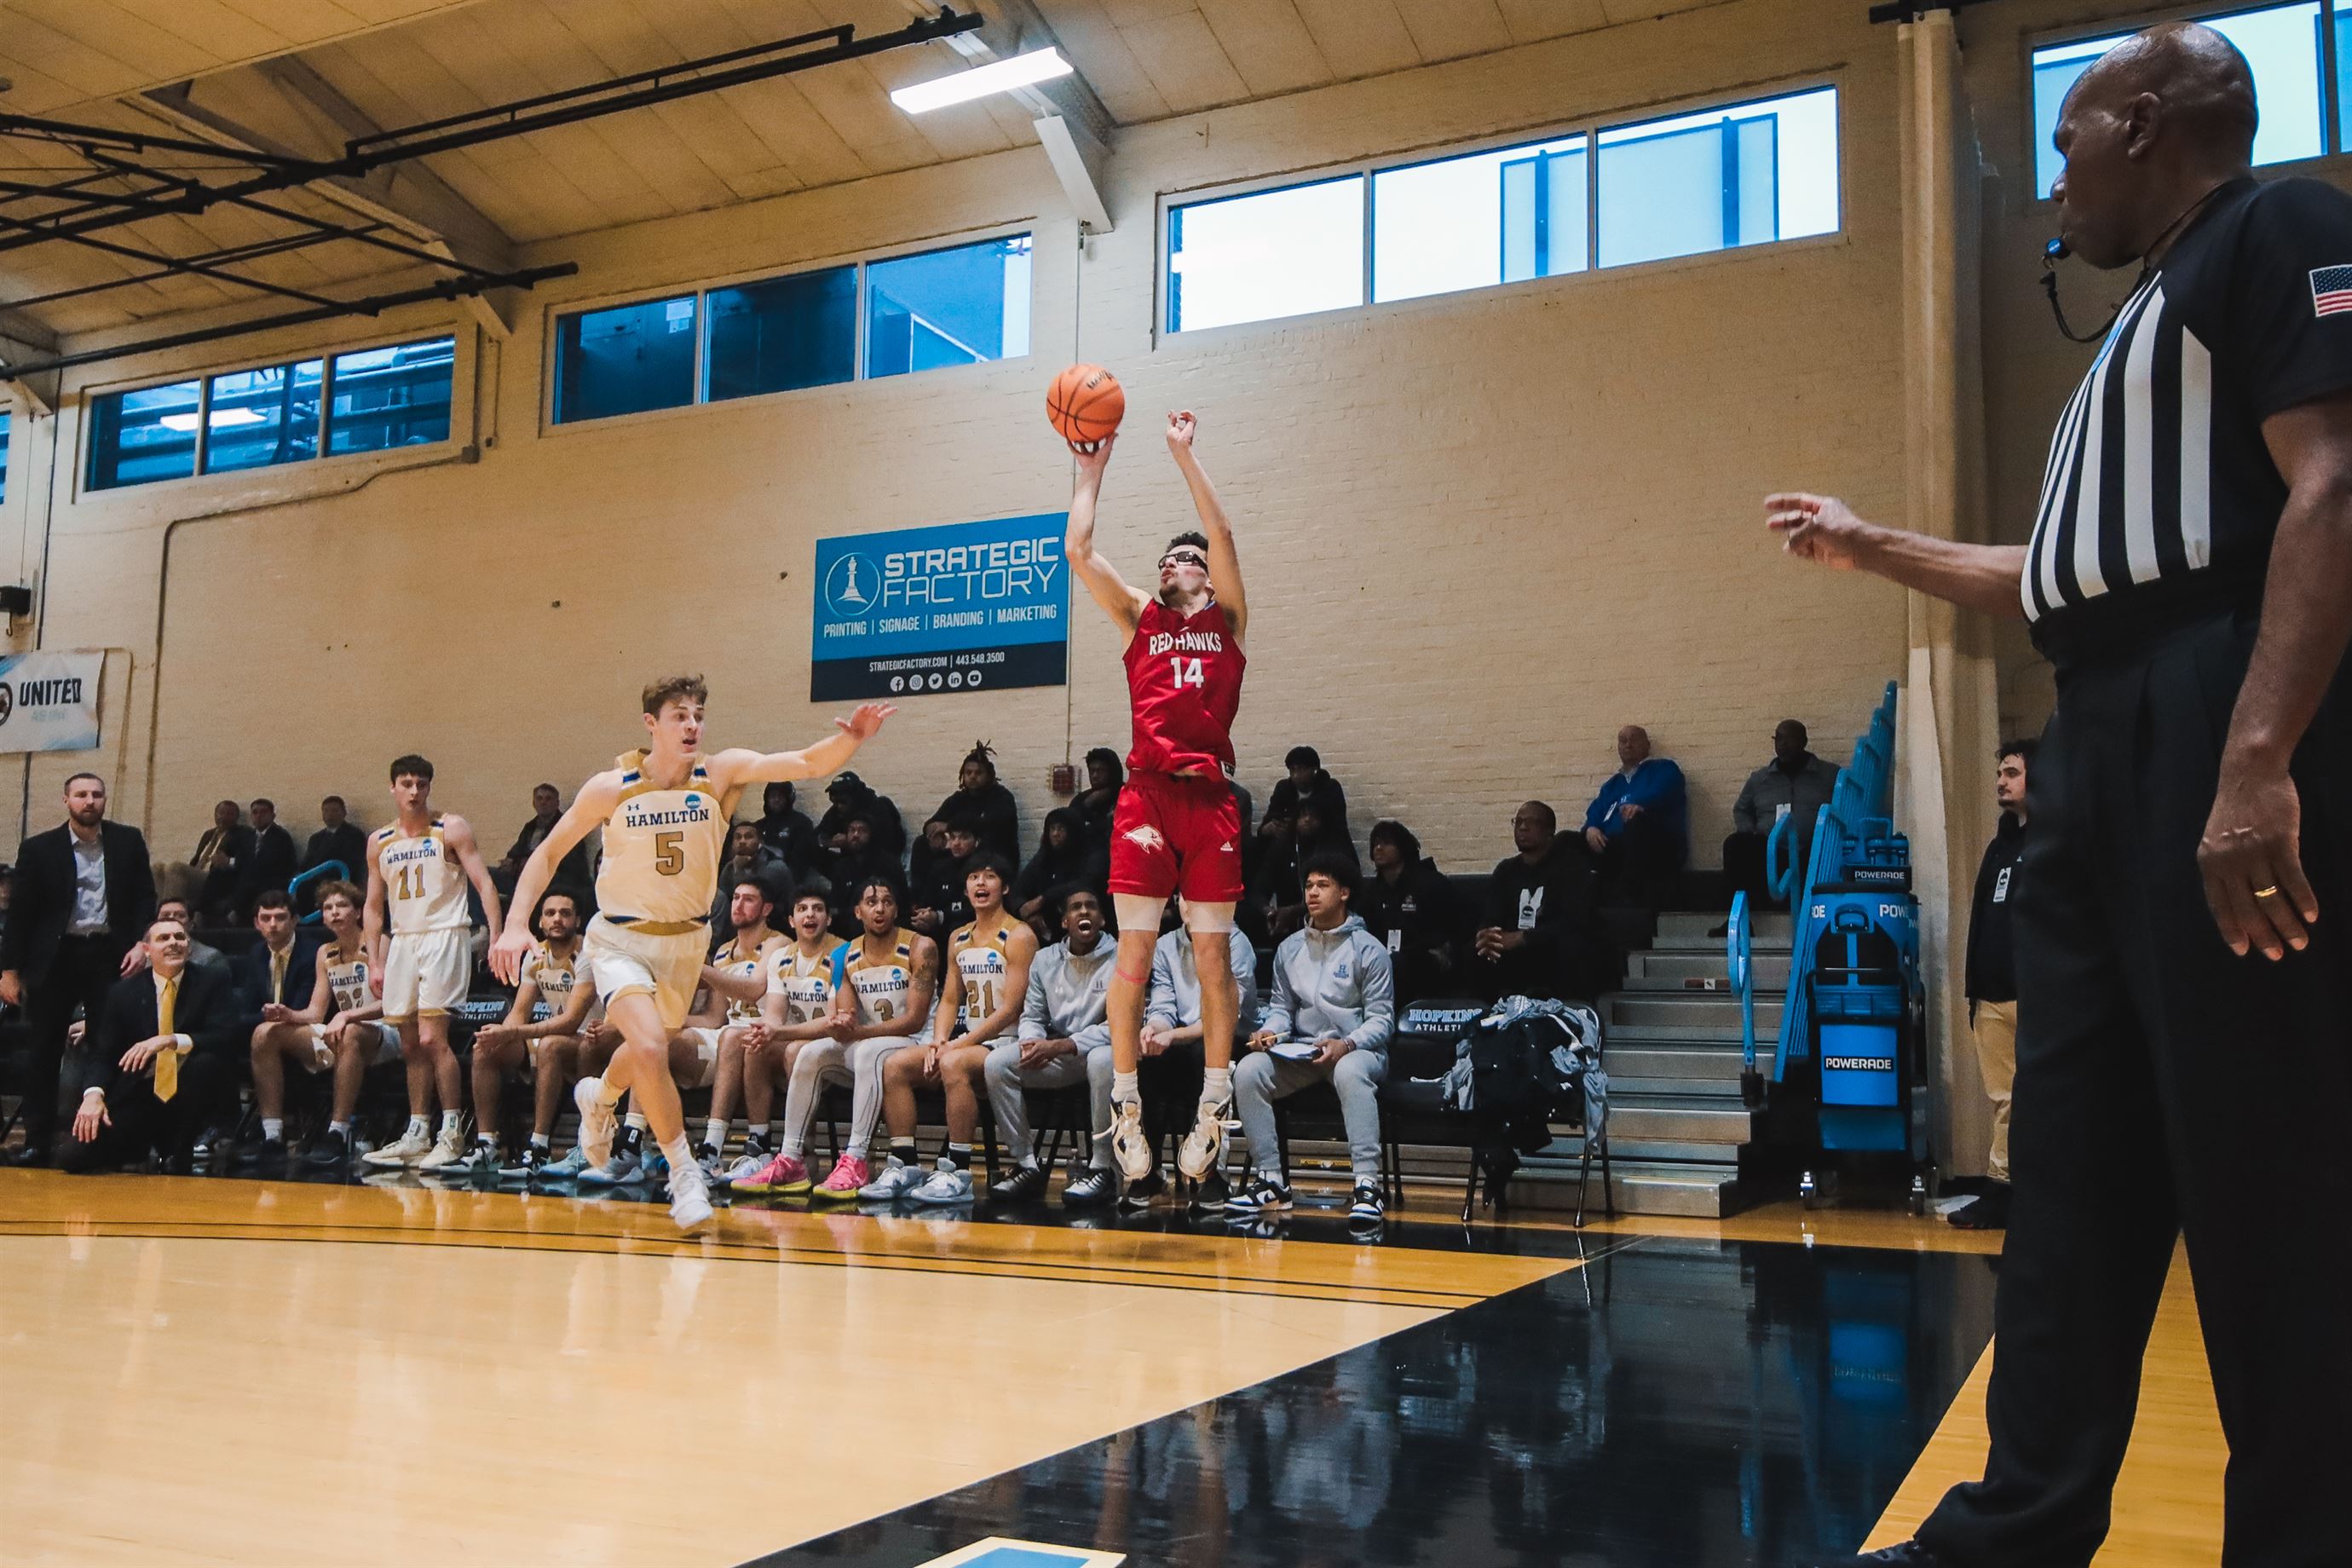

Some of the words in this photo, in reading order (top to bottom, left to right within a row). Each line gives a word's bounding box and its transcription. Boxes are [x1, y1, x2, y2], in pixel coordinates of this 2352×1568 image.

[884, 536, 1059, 578] STRATEGIC
[883, 563, 1058, 608] FACTORY
[824, 620, 867, 638] PRINTING
[879, 615, 920, 634] SIGNAGE
[933, 610, 983, 629] BRANDING
[997, 603, 1057, 624] MARKETING
[869, 656, 948, 672] STRATEGICFACTORY.COM
[955, 651, 1005, 666] 443.548.3500
[1170, 656, 1204, 689] 14
[19, 677, 82, 707] UNITED
[625, 808, 710, 828] HAMILTON
[655, 831, 684, 876] 5
[399, 863, 426, 900] 11
[1854, 870, 1905, 880] POWERADE
[960, 964, 1003, 974] AMILTON
[787, 990, 827, 1002] AMILTON
[966, 980, 996, 1018] 21
[1825, 1058, 1892, 1069] POWERADE
